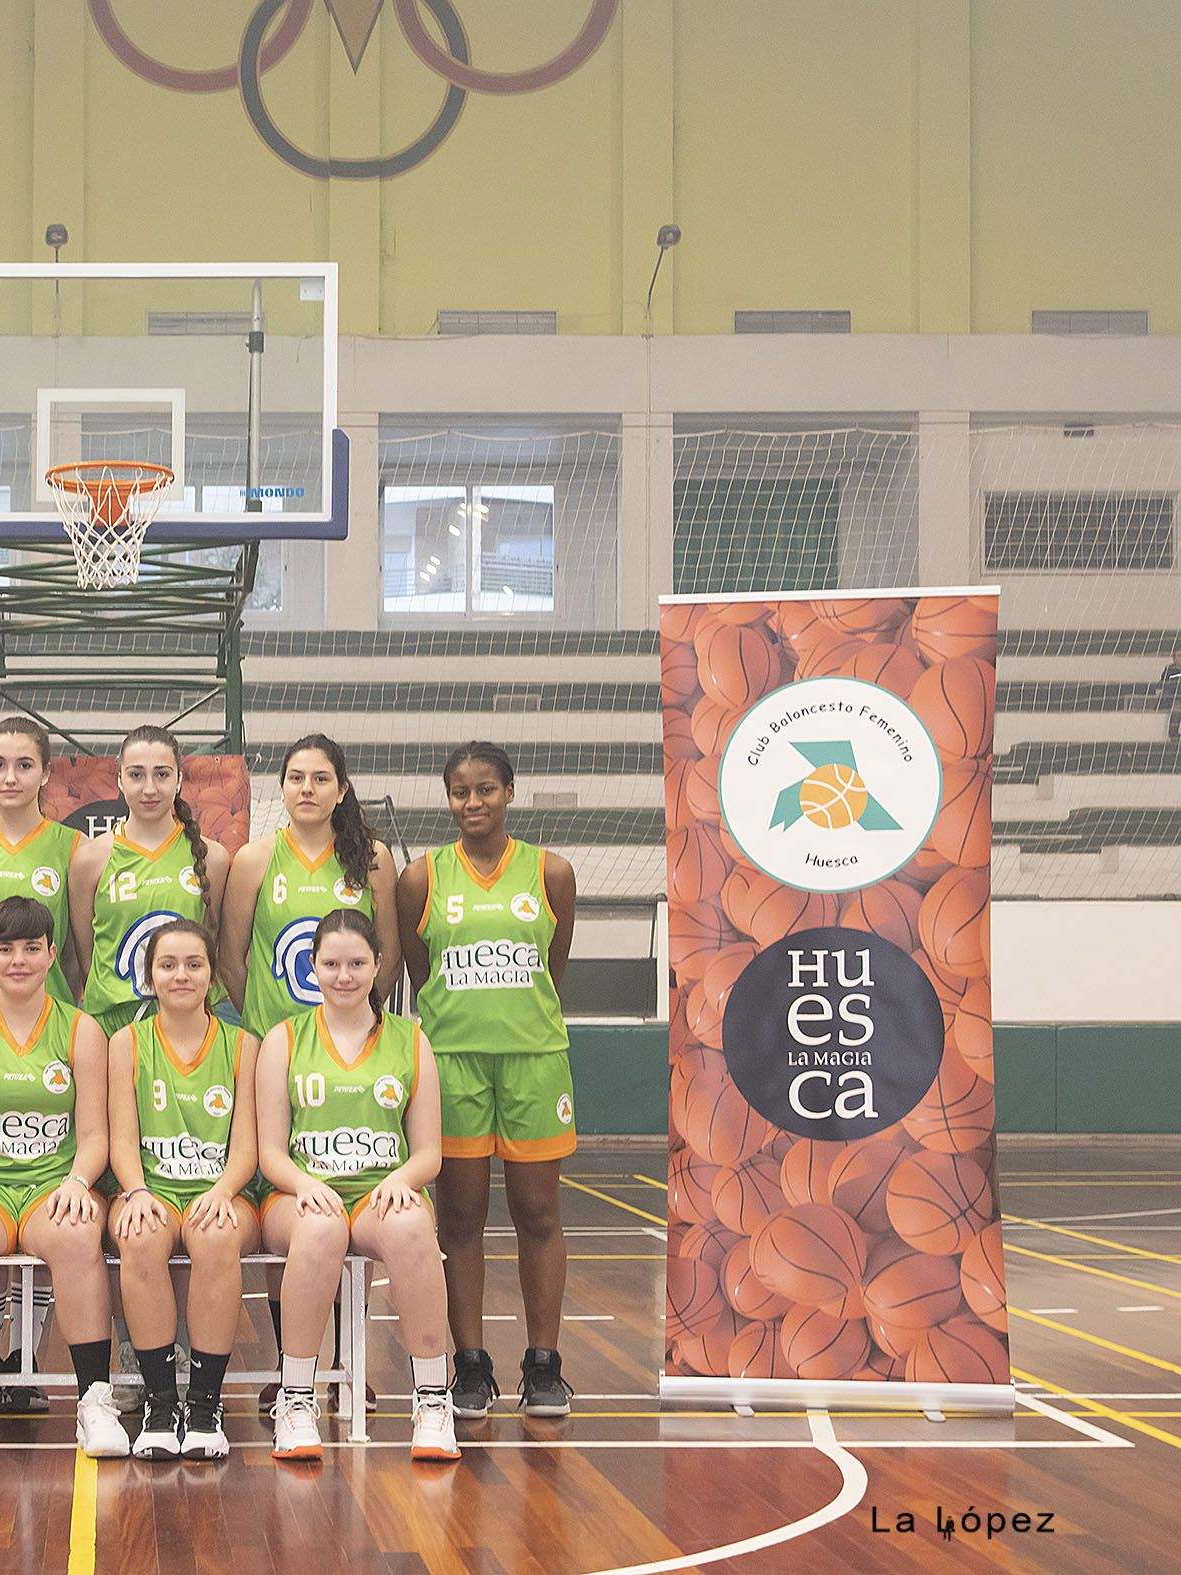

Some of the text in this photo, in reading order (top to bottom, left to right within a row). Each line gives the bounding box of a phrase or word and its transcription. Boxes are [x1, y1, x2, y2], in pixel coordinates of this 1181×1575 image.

[250, 487, 305, 498] MONDO
[748, 701, 913, 766] Club Baloncesto Femenino
[804, 853, 859, 868] Huesca
[108, 871, 138, 904] 12
[272, 872, 288, 905] 6
[446, 894, 464, 925] 5
[152, 1079, 167, 1112] 9
[294, 1072, 326, 1108] 10
